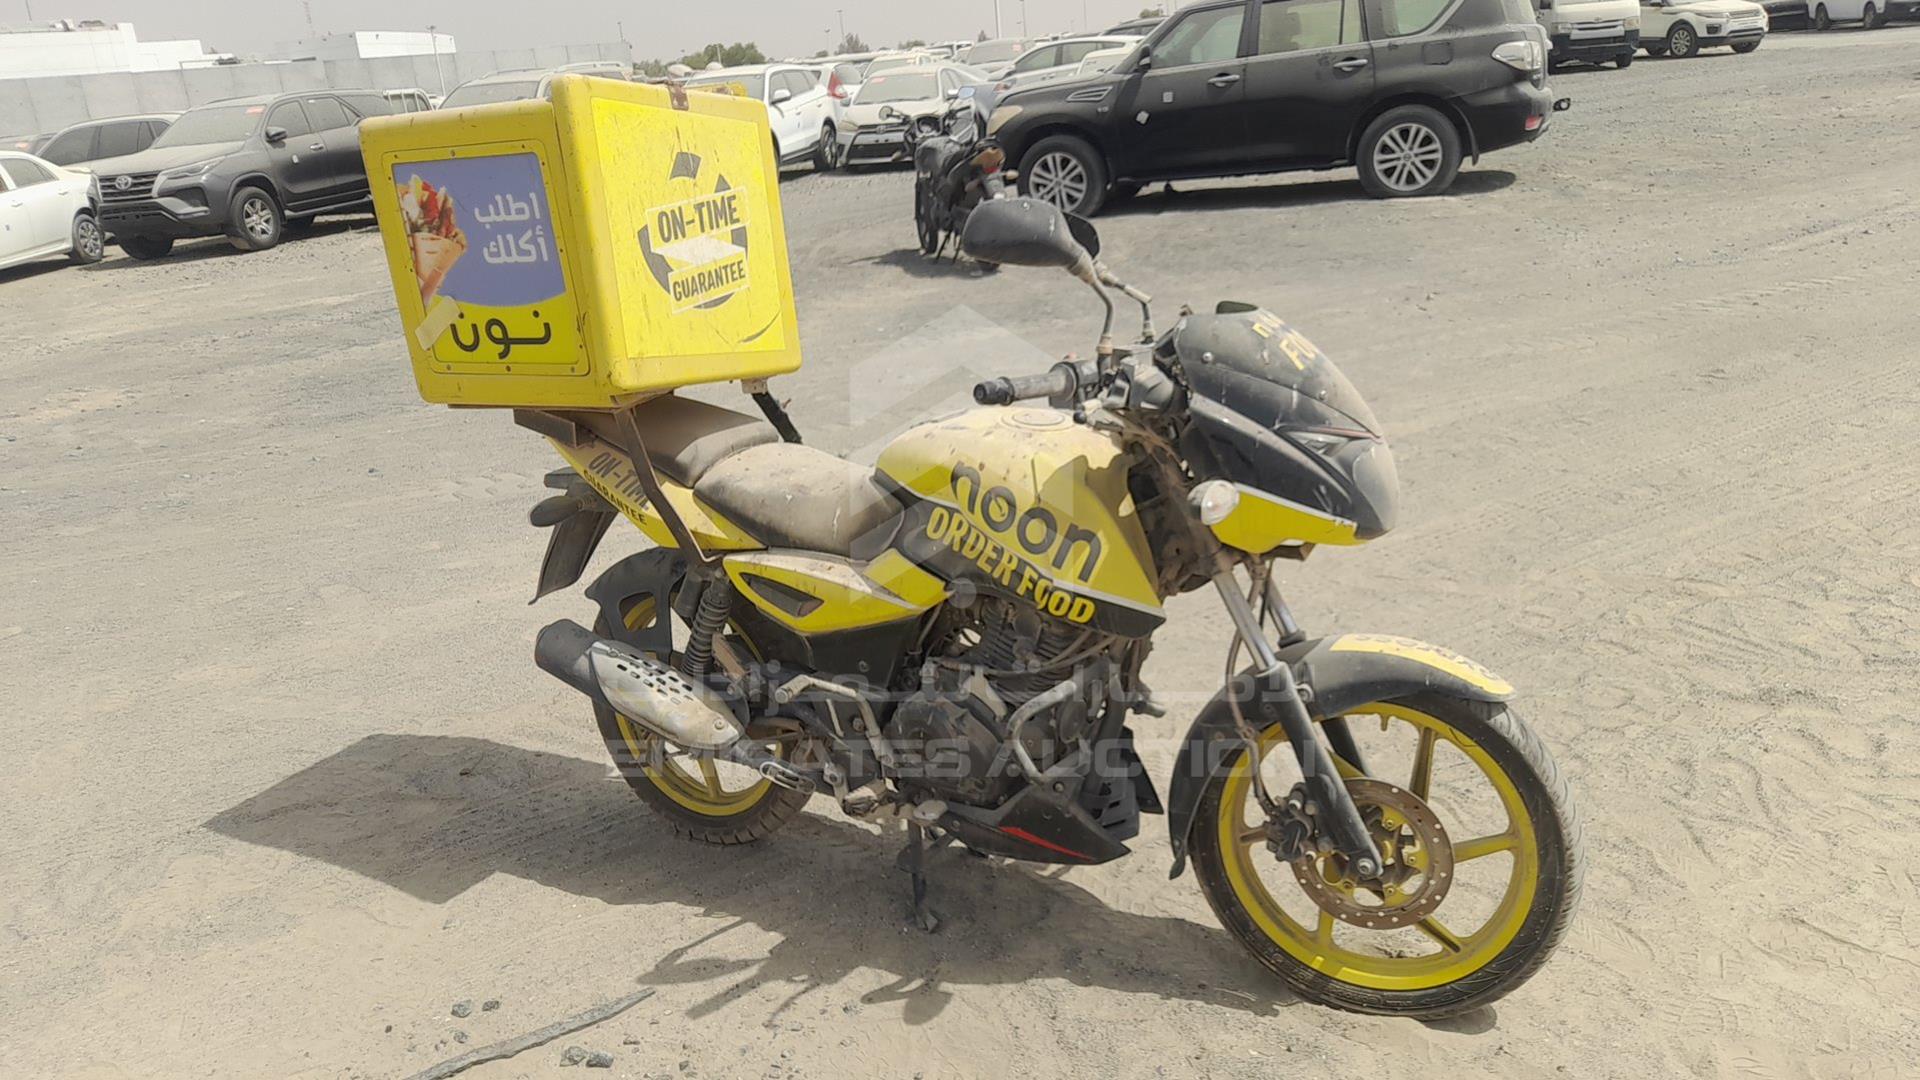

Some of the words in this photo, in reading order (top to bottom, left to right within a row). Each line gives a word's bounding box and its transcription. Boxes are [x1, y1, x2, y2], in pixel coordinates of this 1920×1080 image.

[474, 191, 541, 230] اطلب
[657, 194, 741, 243] ON-TIME
[482, 225, 549, 264] أكلك
[672, 259, 746, 302] GUARANTEE
[450, 309, 552, 360] نون
[583, 468, 648, 526] GUARANTEE
[950, 460, 1104, 583] noon
[926, 506, 1018, 587] ORDER
[1016, 570, 1096, 624] FOOD
